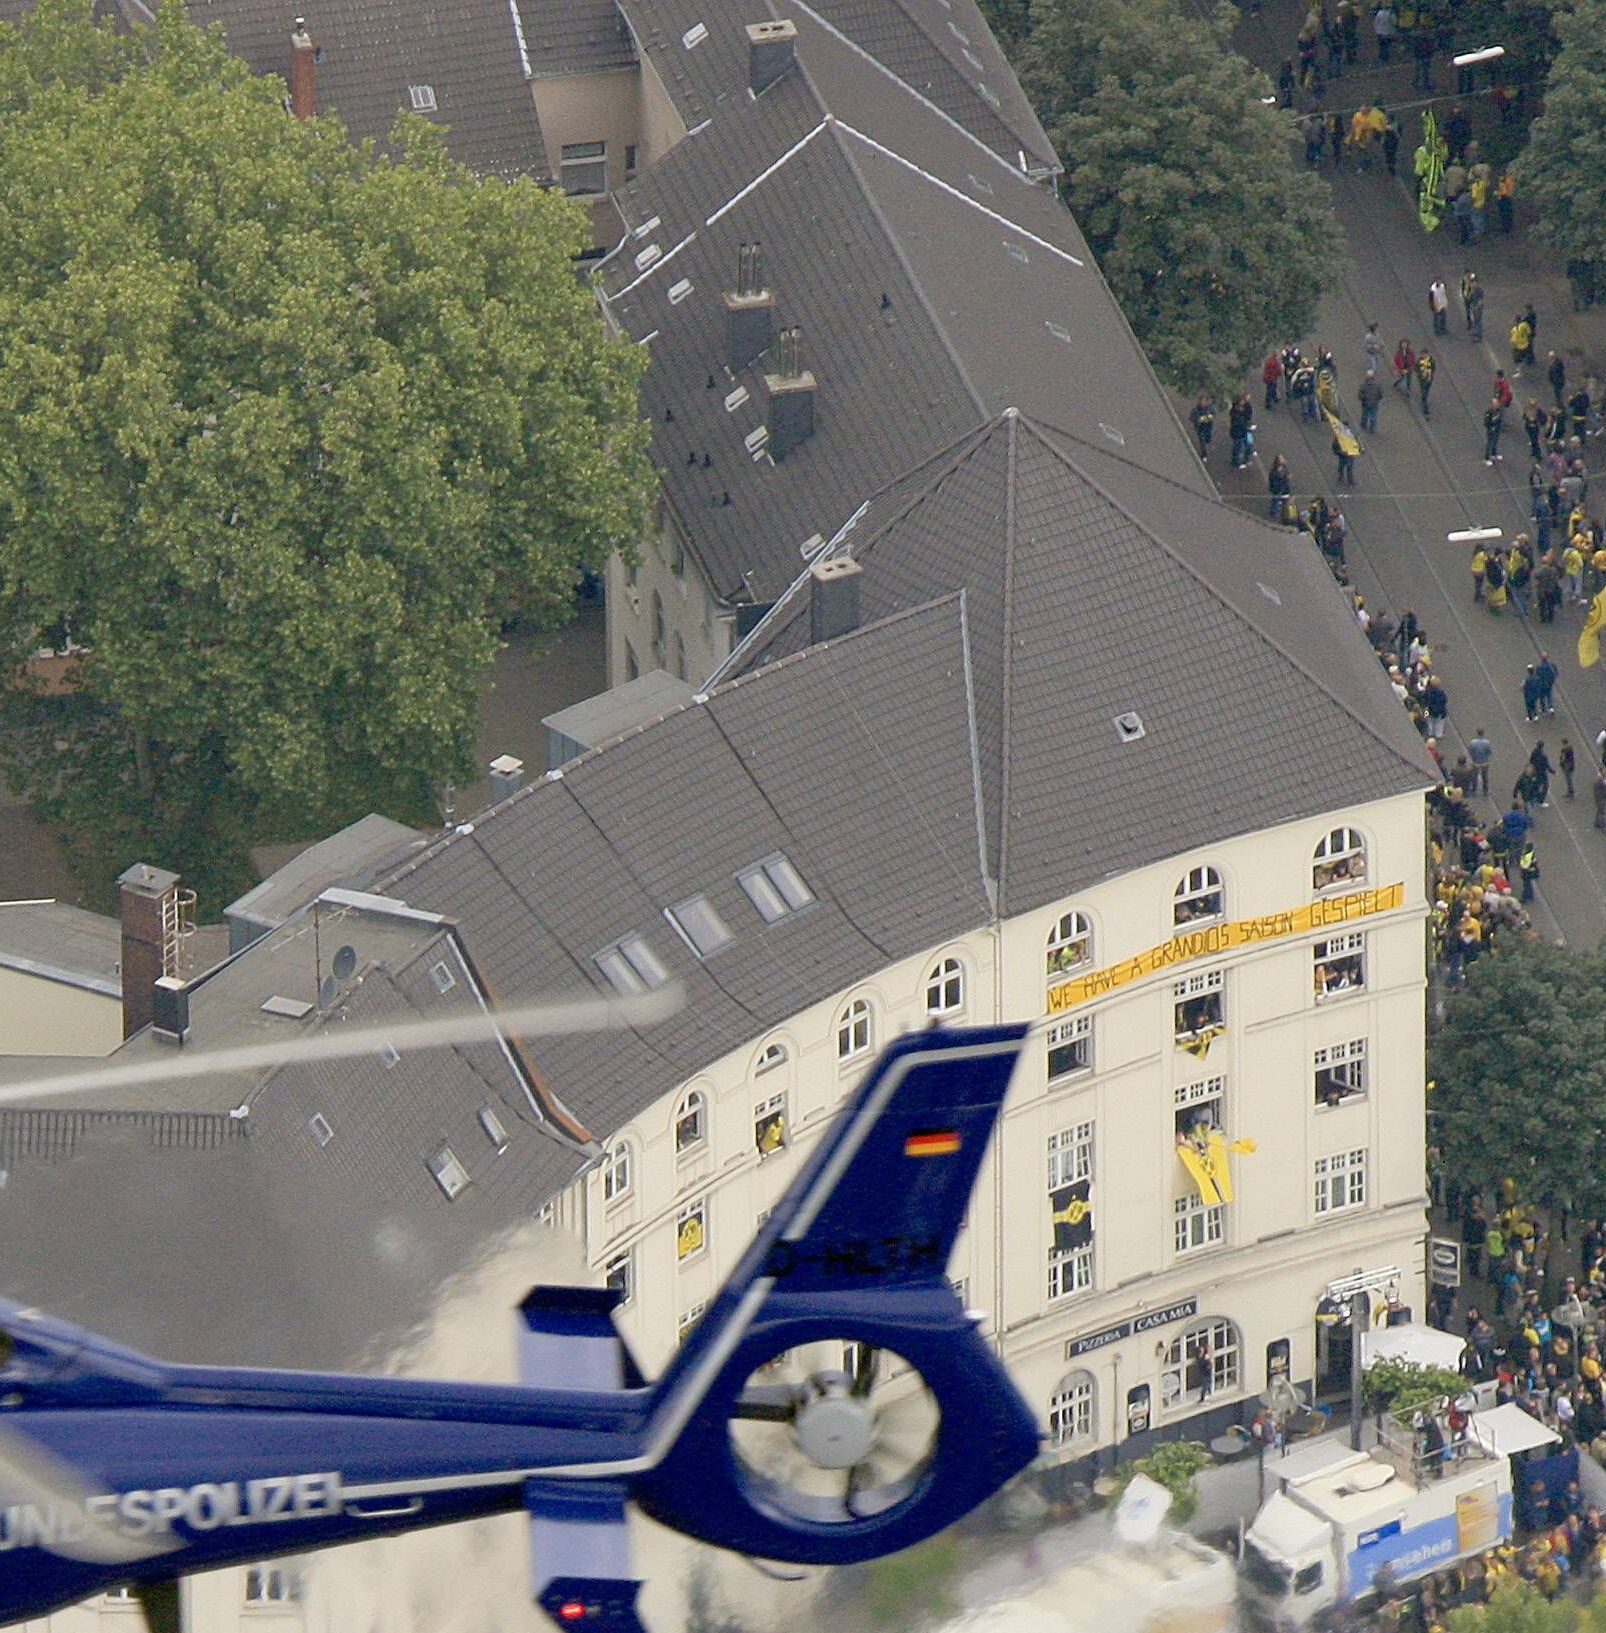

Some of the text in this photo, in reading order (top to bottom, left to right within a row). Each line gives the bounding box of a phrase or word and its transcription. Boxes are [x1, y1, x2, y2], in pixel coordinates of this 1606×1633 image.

[1049, 983, 1072, 1009] WE
[1083, 964, 1121, 999] HAVE
[1129, 957, 1142, 980] A
[1310, 881, 1403, 928] GESPIELT
[1136, 1311, 1169, 1331] CASA
